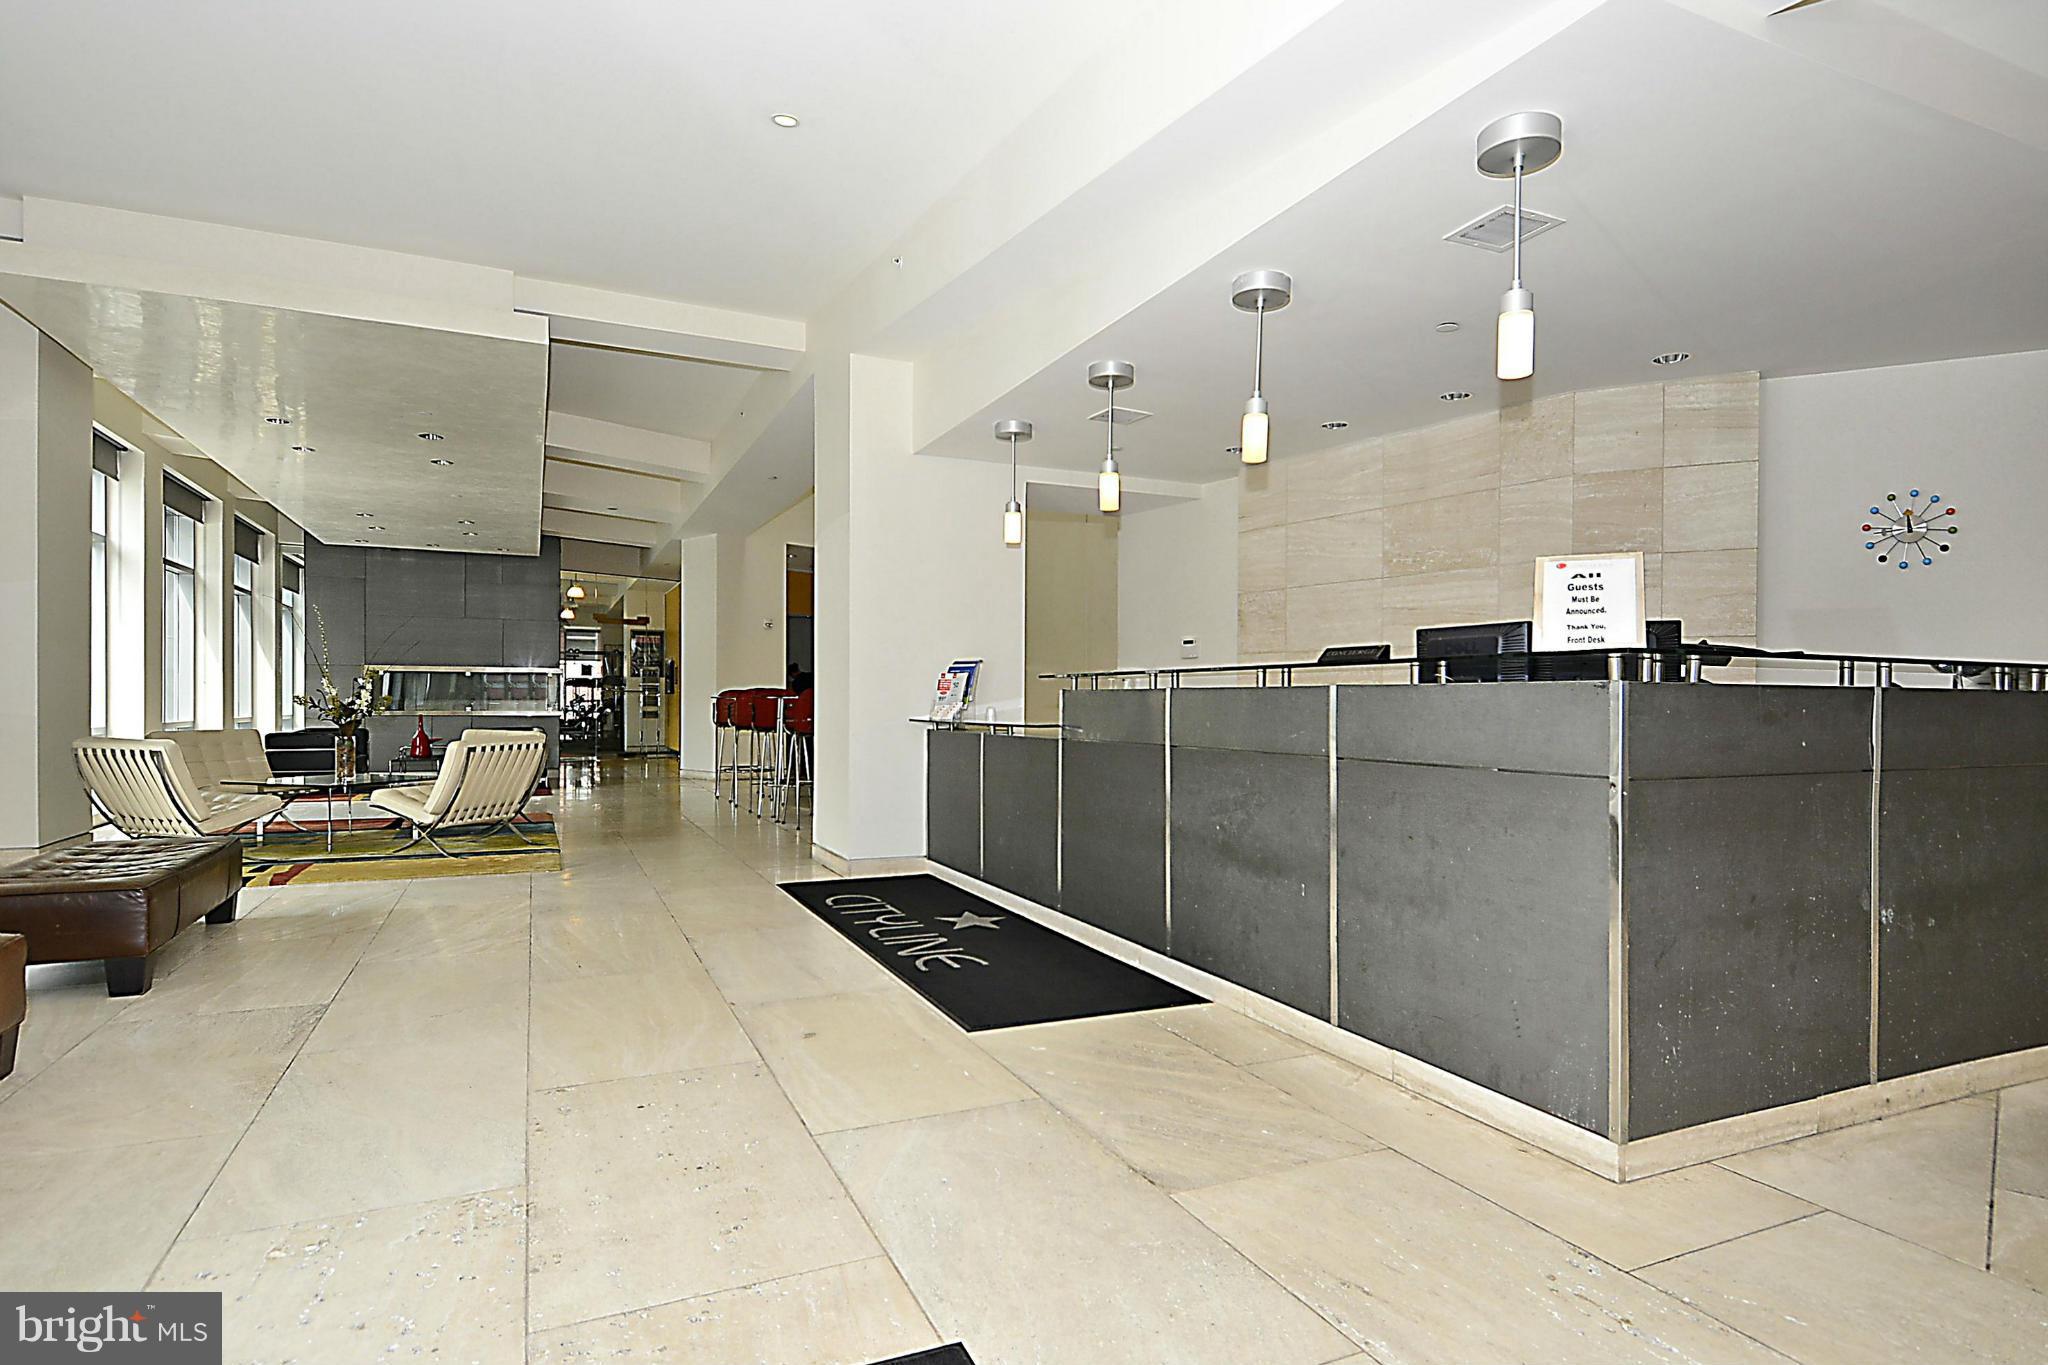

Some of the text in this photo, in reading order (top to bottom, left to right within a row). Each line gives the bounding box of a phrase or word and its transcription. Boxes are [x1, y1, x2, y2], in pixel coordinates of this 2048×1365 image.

[1567, 583, 1604, 592] Guests
[1571, 595, 1600, 603] Must Be
[1567, 636, 1605, 644] Front Desk
[825, 894, 990, 972] CITYLINE
